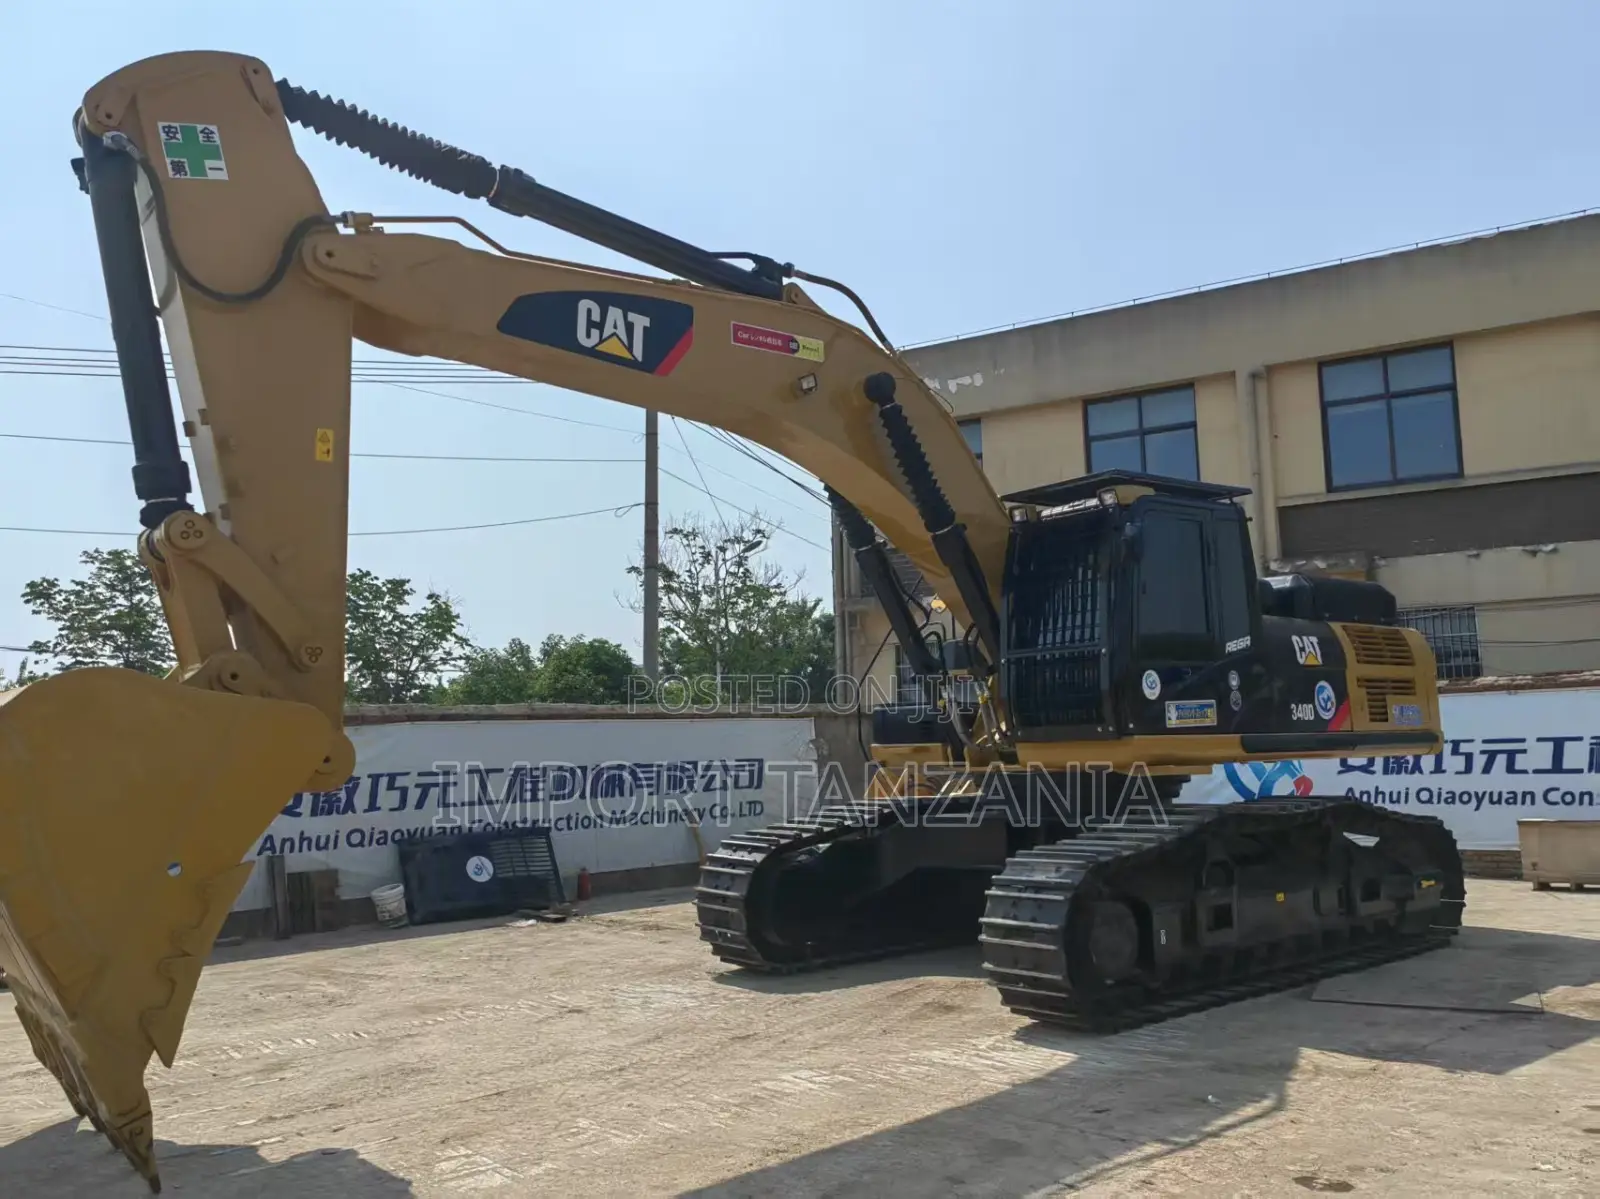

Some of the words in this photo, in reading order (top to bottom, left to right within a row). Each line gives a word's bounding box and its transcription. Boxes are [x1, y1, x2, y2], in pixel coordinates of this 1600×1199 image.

[577, 299, 650, 362] CAT
[1291, 635, 1323, 665] CAT
[1291, 703, 1315, 720] 340D
[1344, 785, 1410, 805] Anhui
[1415, 786, 1535, 811] Qiaoyuan
[1542, 787, 1600, 806] Con
[257, 829, 341, 856] Anhui
[738, 800, 764, 818] LTD
